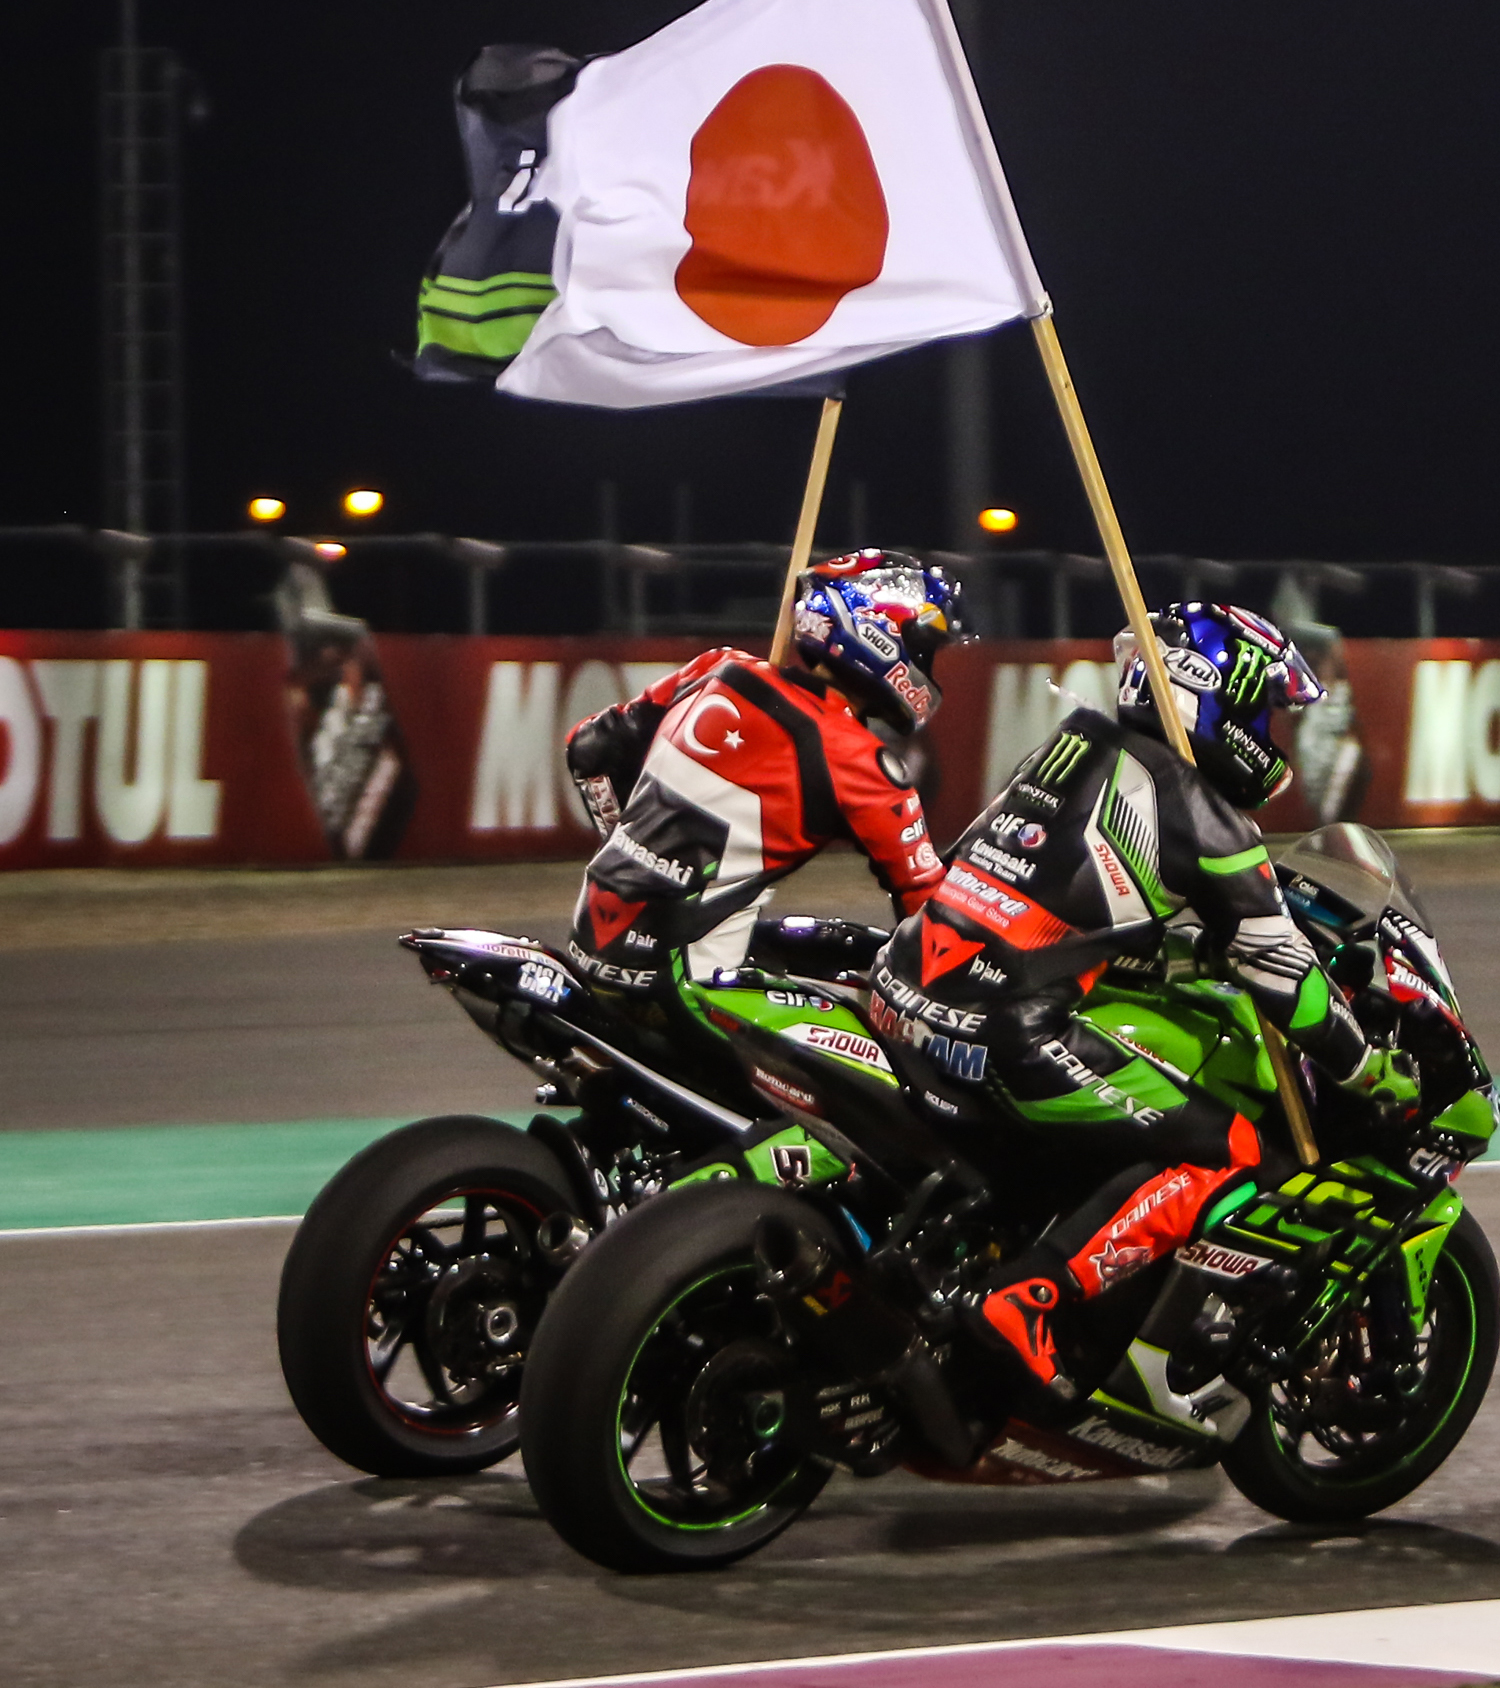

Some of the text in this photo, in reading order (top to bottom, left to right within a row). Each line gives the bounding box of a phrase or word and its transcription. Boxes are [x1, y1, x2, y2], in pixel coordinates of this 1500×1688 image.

[861, 625, 896, 657] SHOEI
[1222, 720, 1271, 769] MONSTER
[990, 812, 1026, 836] elf
[970, 838, 1037, 880] Kawasaki
[1093, 842, 1131, 897] SHOWA
[876, 966, 988, 1034] DAINESE
[806, 1026, 880, 1062] SHOWA
[1039, 1039, 1166, 1127] DAINESE
[1110, 1171, 1192, 1239] DAINESE
[1181, 1245, 1259, 1276] SHOWA
